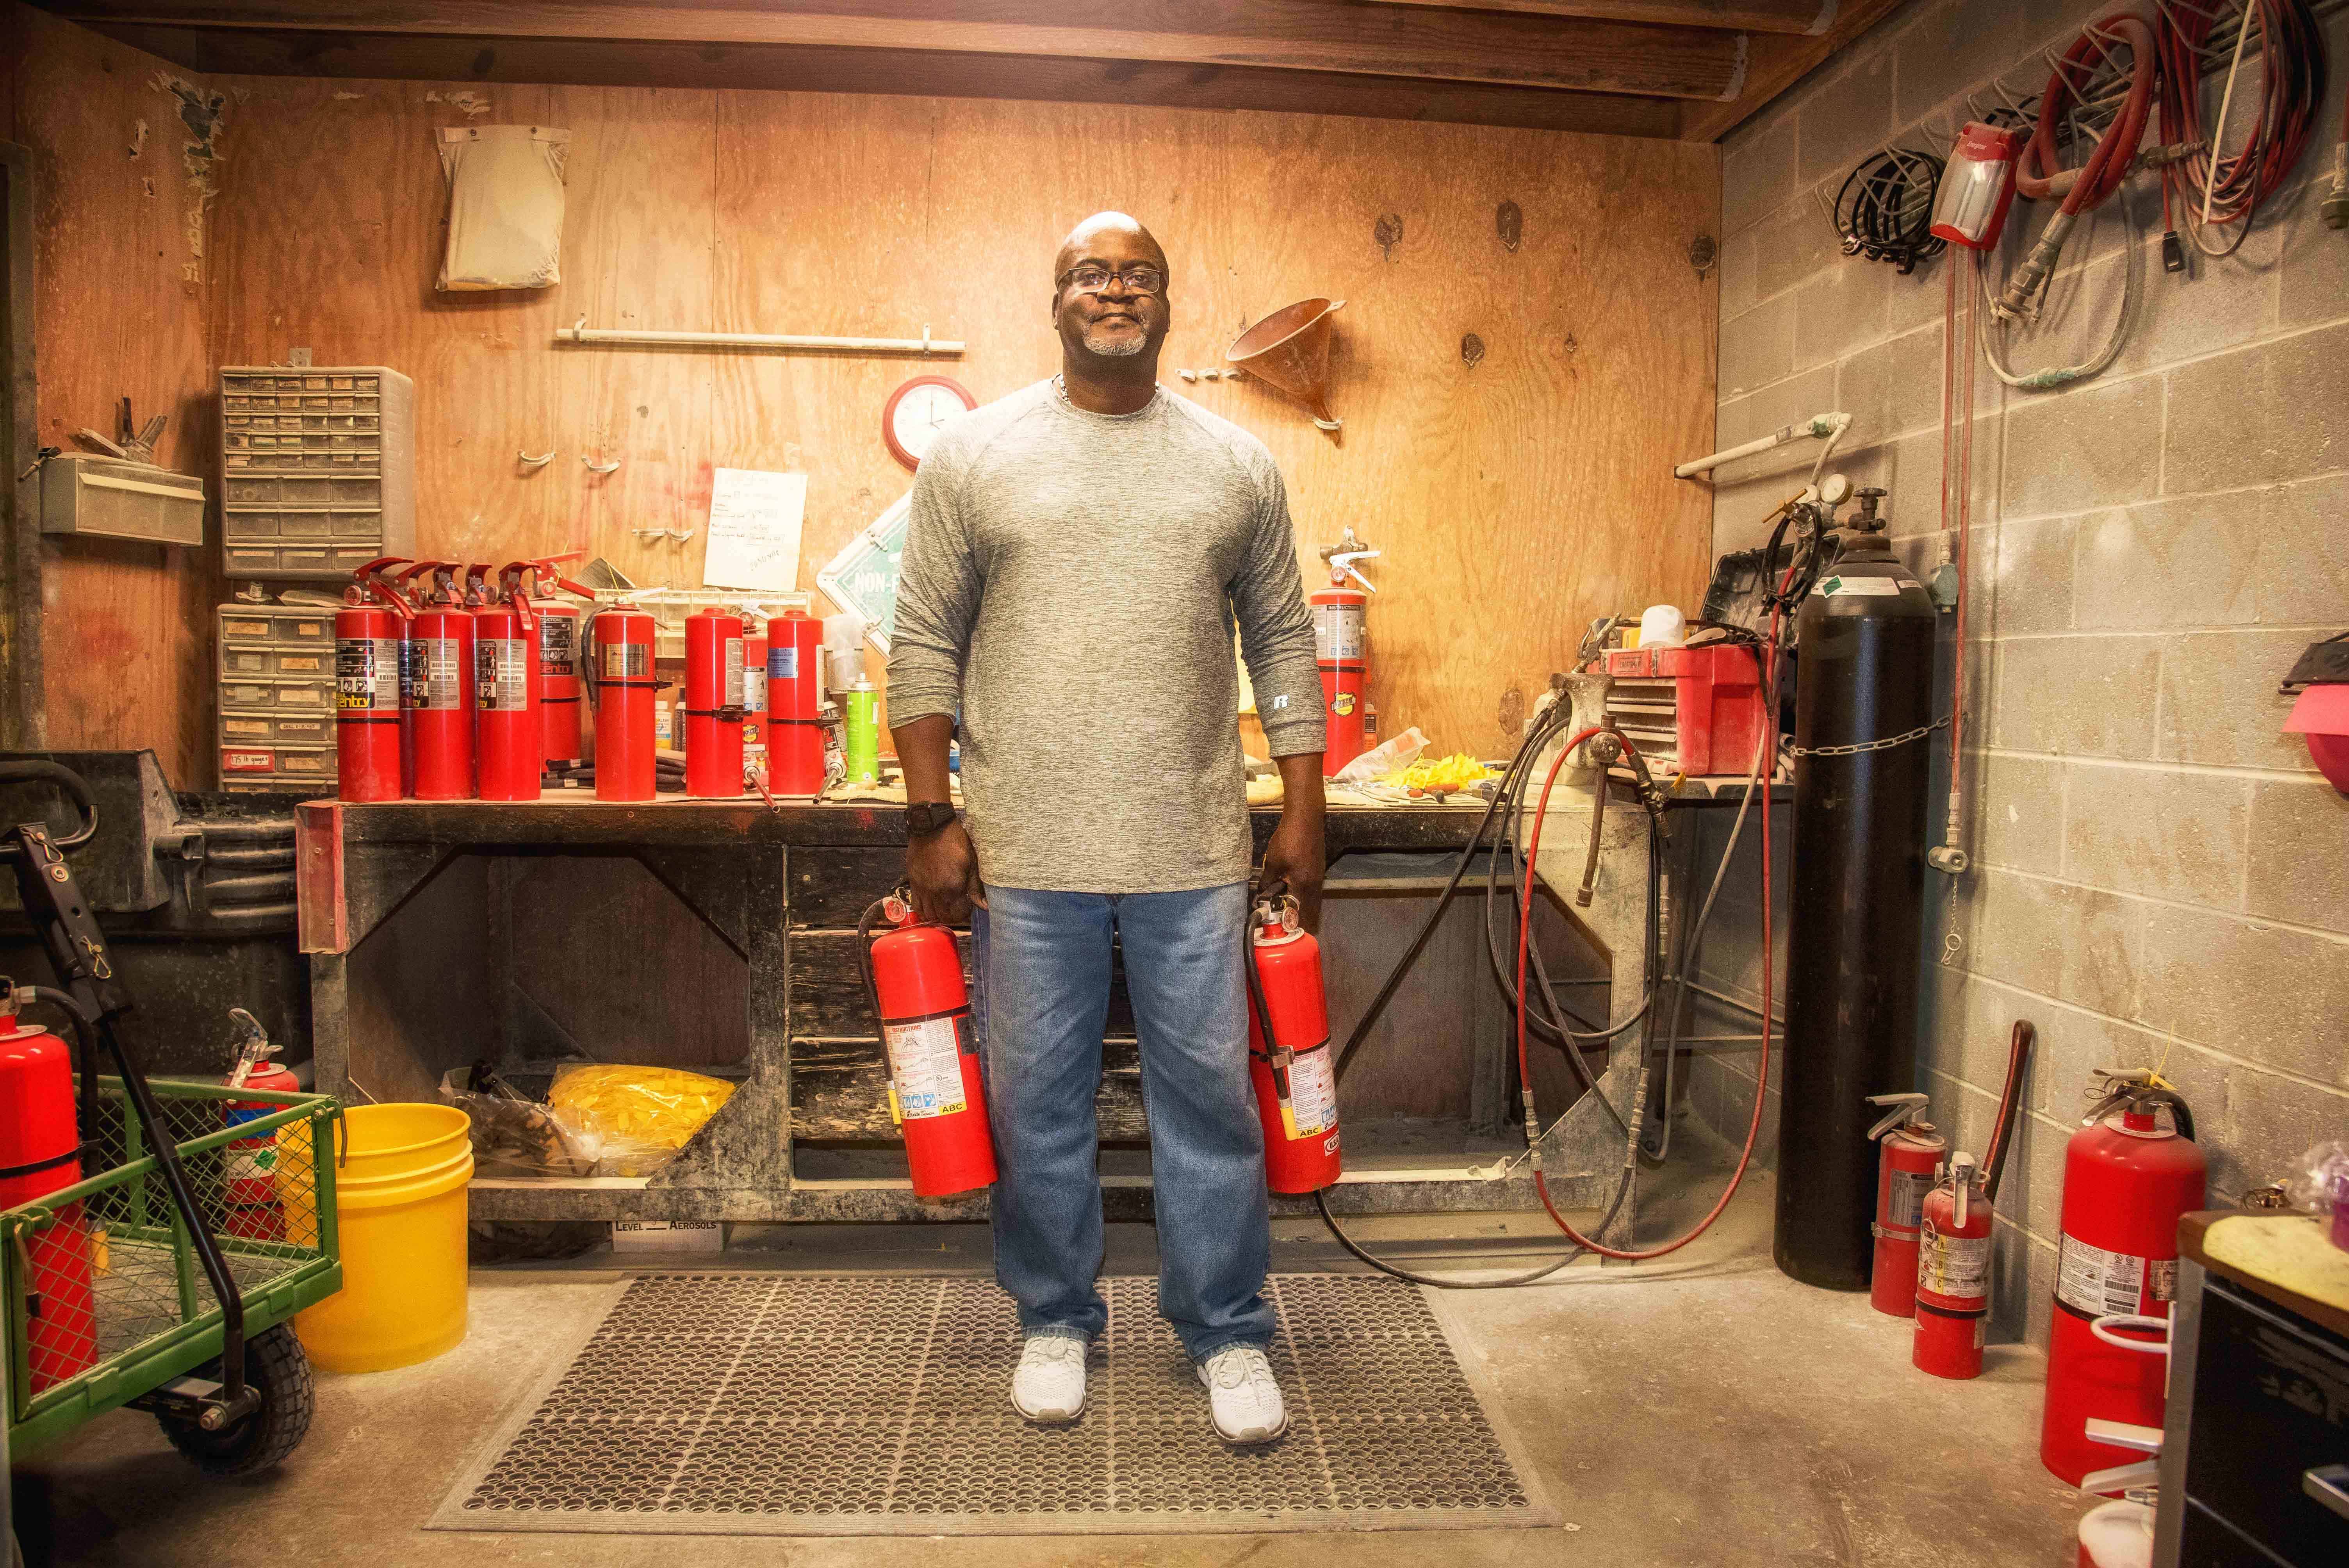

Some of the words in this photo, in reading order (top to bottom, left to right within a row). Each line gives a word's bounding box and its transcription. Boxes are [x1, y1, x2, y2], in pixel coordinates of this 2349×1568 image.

[1274, 695, 1288, 709] R
[232, 755, 241, 764] 175
[942, 1103, 962, 1113] ABC
[1299, 1127, 1319, 1137] ABC
[1937, 1279, 1941, 1288] C
